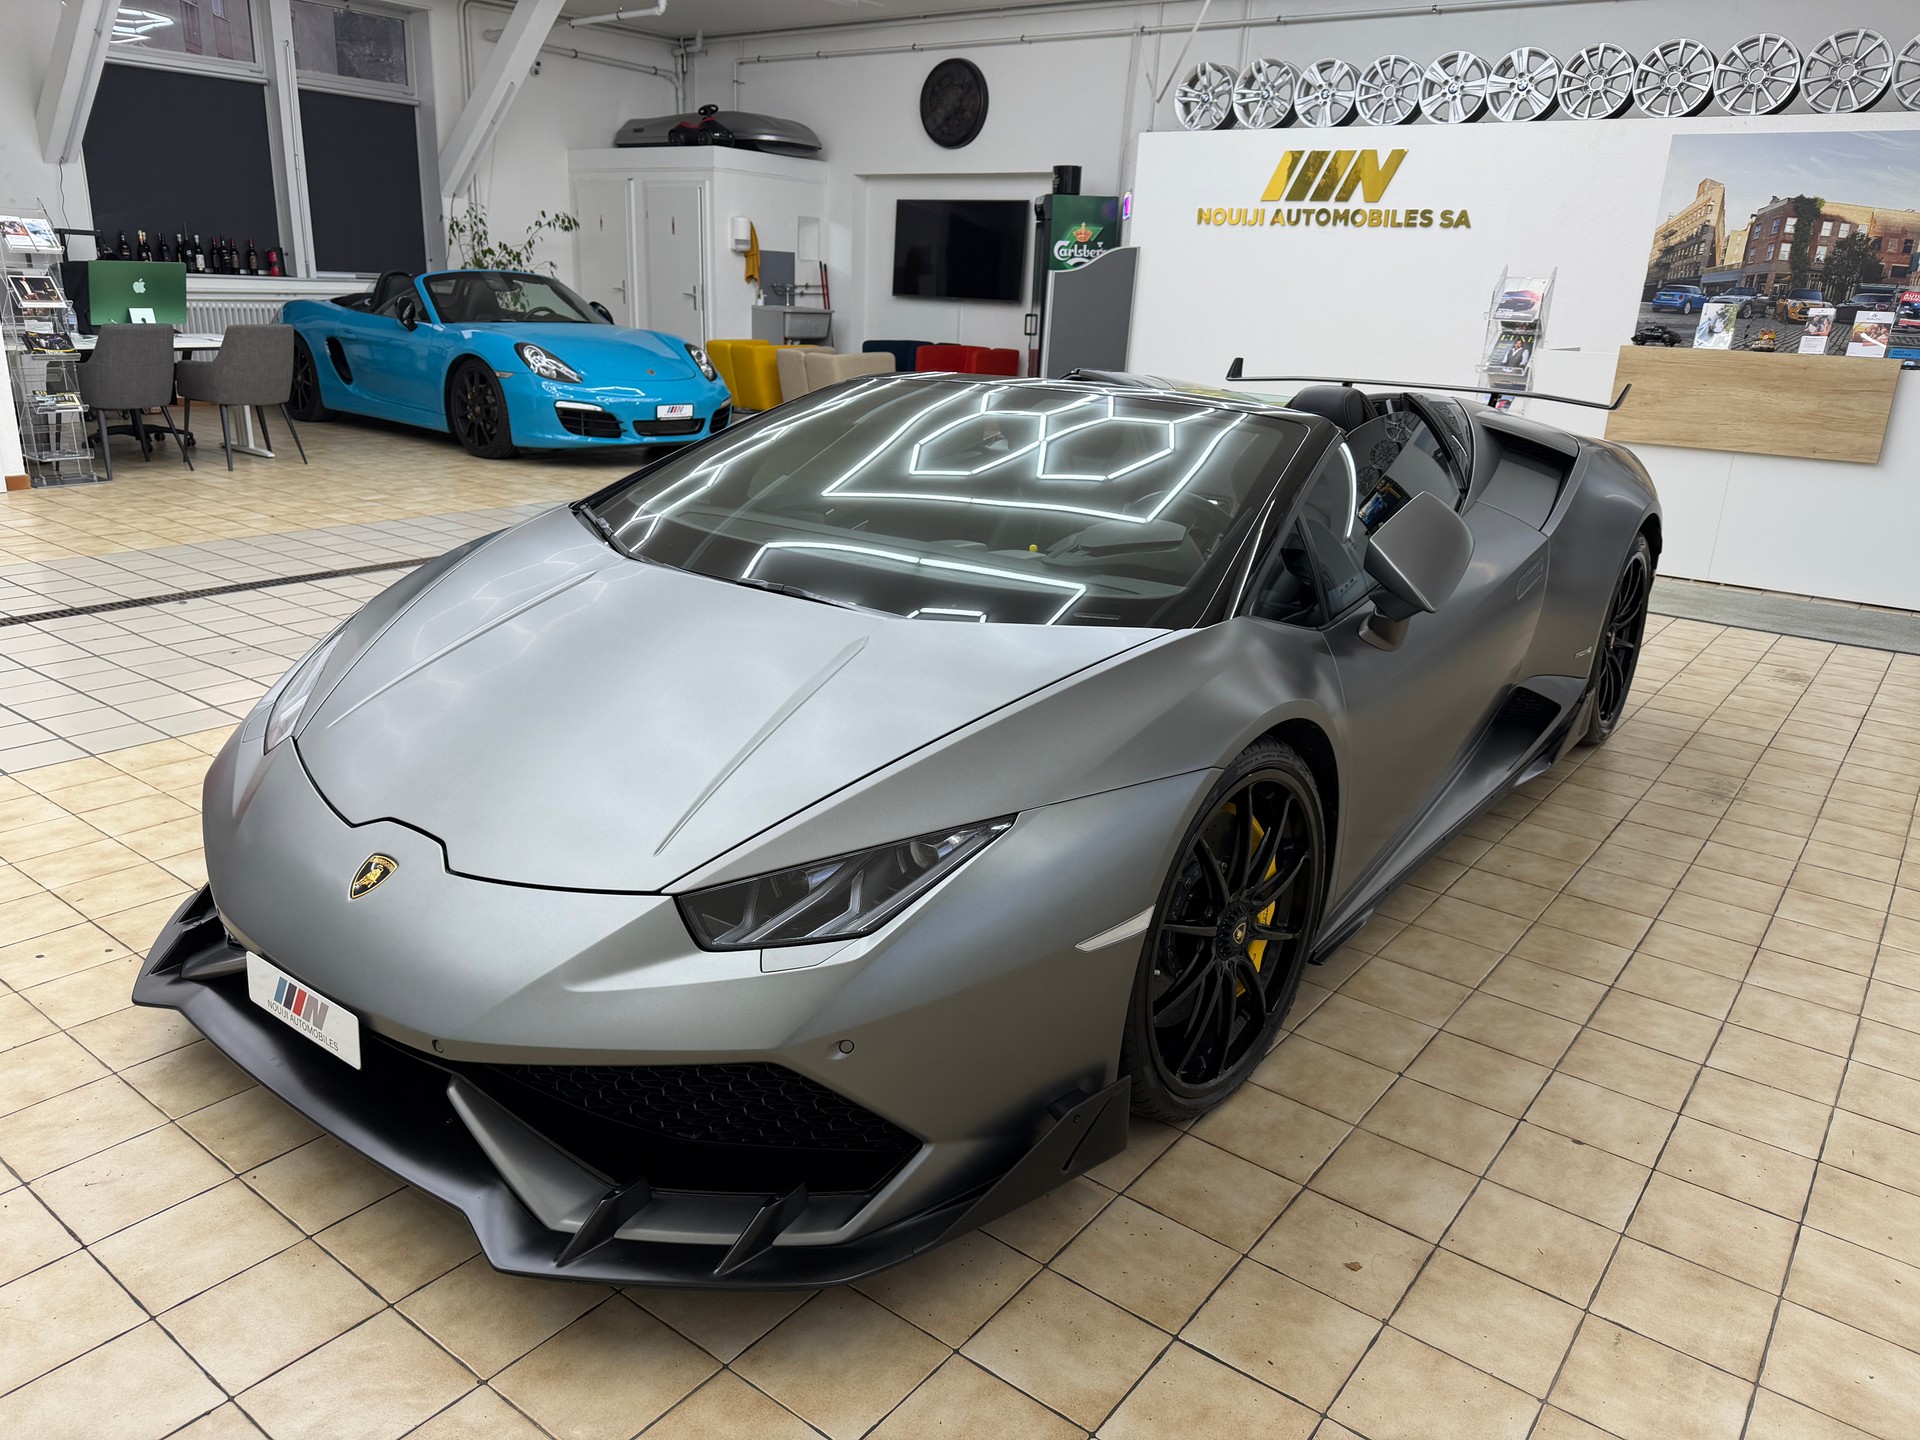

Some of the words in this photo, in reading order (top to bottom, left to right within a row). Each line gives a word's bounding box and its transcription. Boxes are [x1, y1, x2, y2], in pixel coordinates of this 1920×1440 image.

[1196, 207, 1265, 227] NOUIJI
[1269, 207, 1434, 229] AUTOMOBILES
[1438, 209, 1471, 229] SA
[1053, 240, 1107, 261] Carlsber
[267, 998, 289, 1020] NOUIJI
[289, 1013, 339, 1052] AUTOMOBILES
